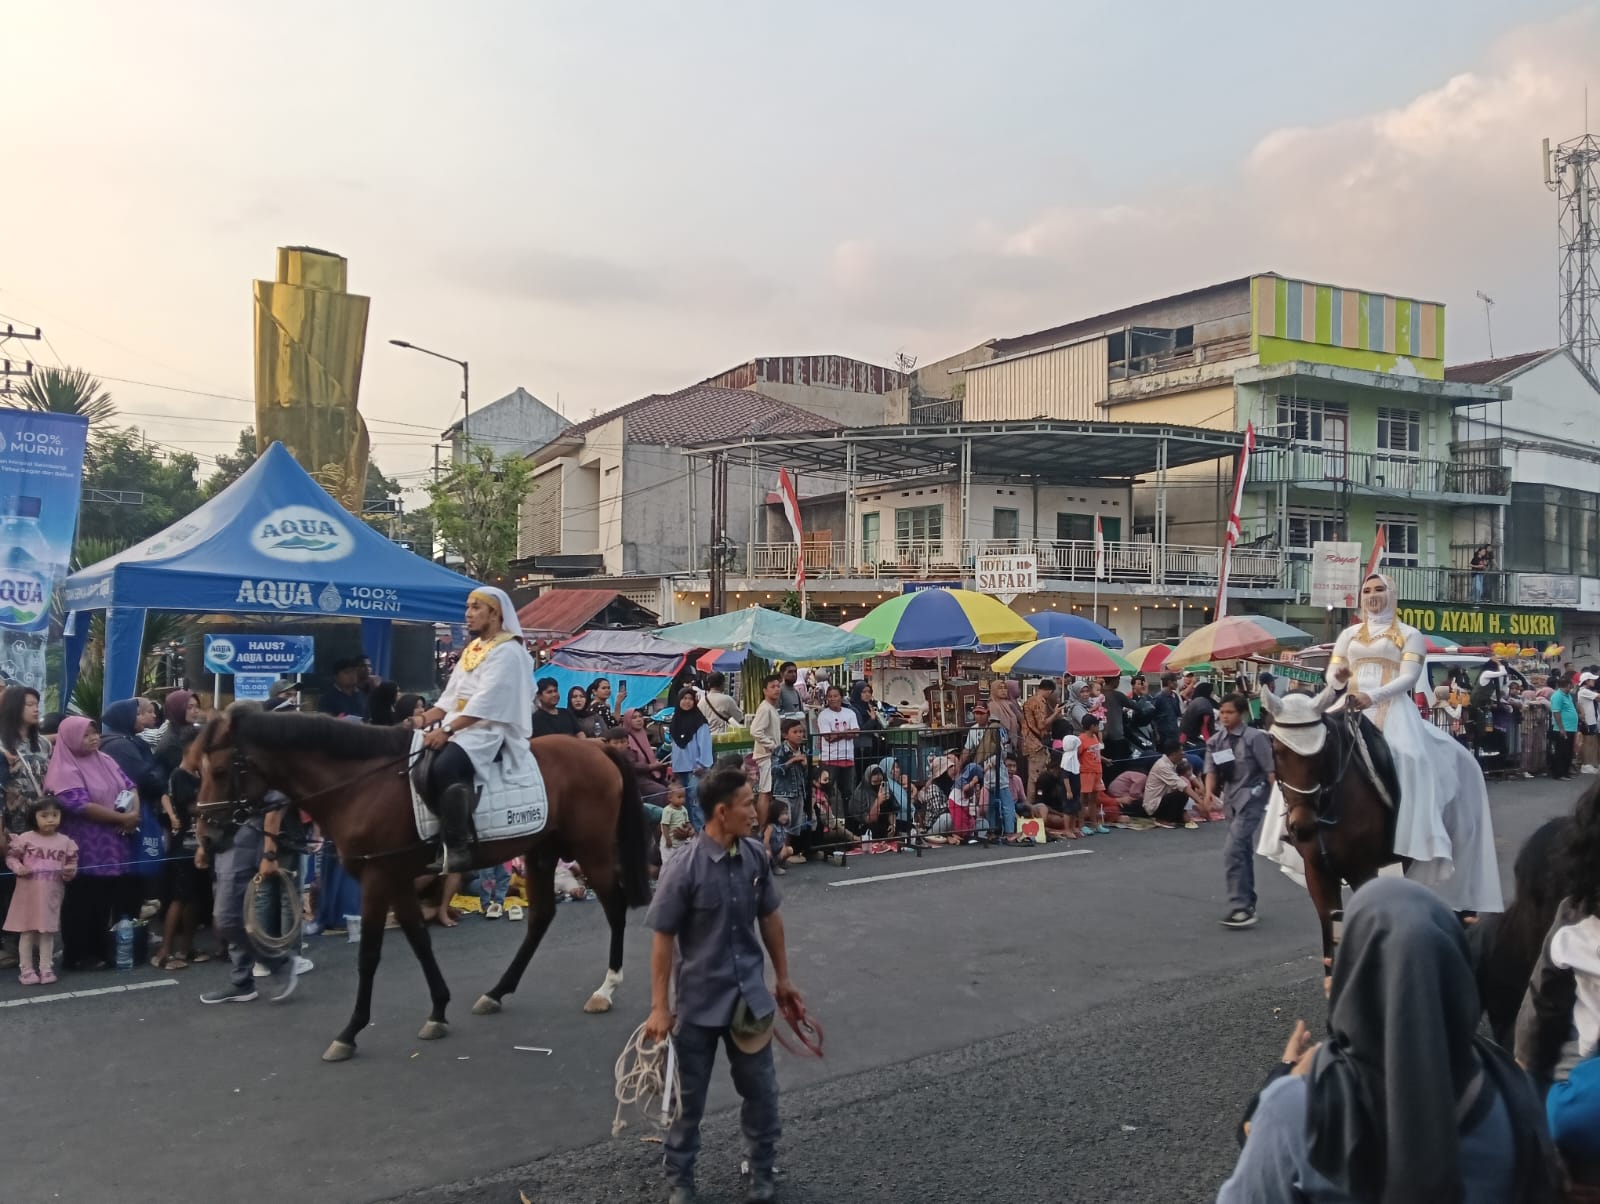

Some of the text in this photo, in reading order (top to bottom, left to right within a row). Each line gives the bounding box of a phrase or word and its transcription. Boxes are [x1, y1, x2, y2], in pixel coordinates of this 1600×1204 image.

[16, 432, 61, 445] 100%
[11, 442, 64, 456] MURNI
[261, 519, 338, 538] AQUA
[980, 560, 1012, 572] HOTEL
[1325, 554, 1360, 566] Royal
[980, 573, 1033, 589] SAFARI
[0, 579, 43, 605] QUA
[236, 580, 313, 609] AQUA
[350, 586, 398, 600] 100%
[345, 599, 401, 612] MURNI
[1440, 611, 1484, 633] AYAM
[1489, 613, 1505, 634] H.
[1510, 614, 1555, 636] SUKRI
[211, 644, 231, 653] AQUA
[248, 641, 286, 650] HAUS?
[236, 653, 295, 663] AQUA DULU
